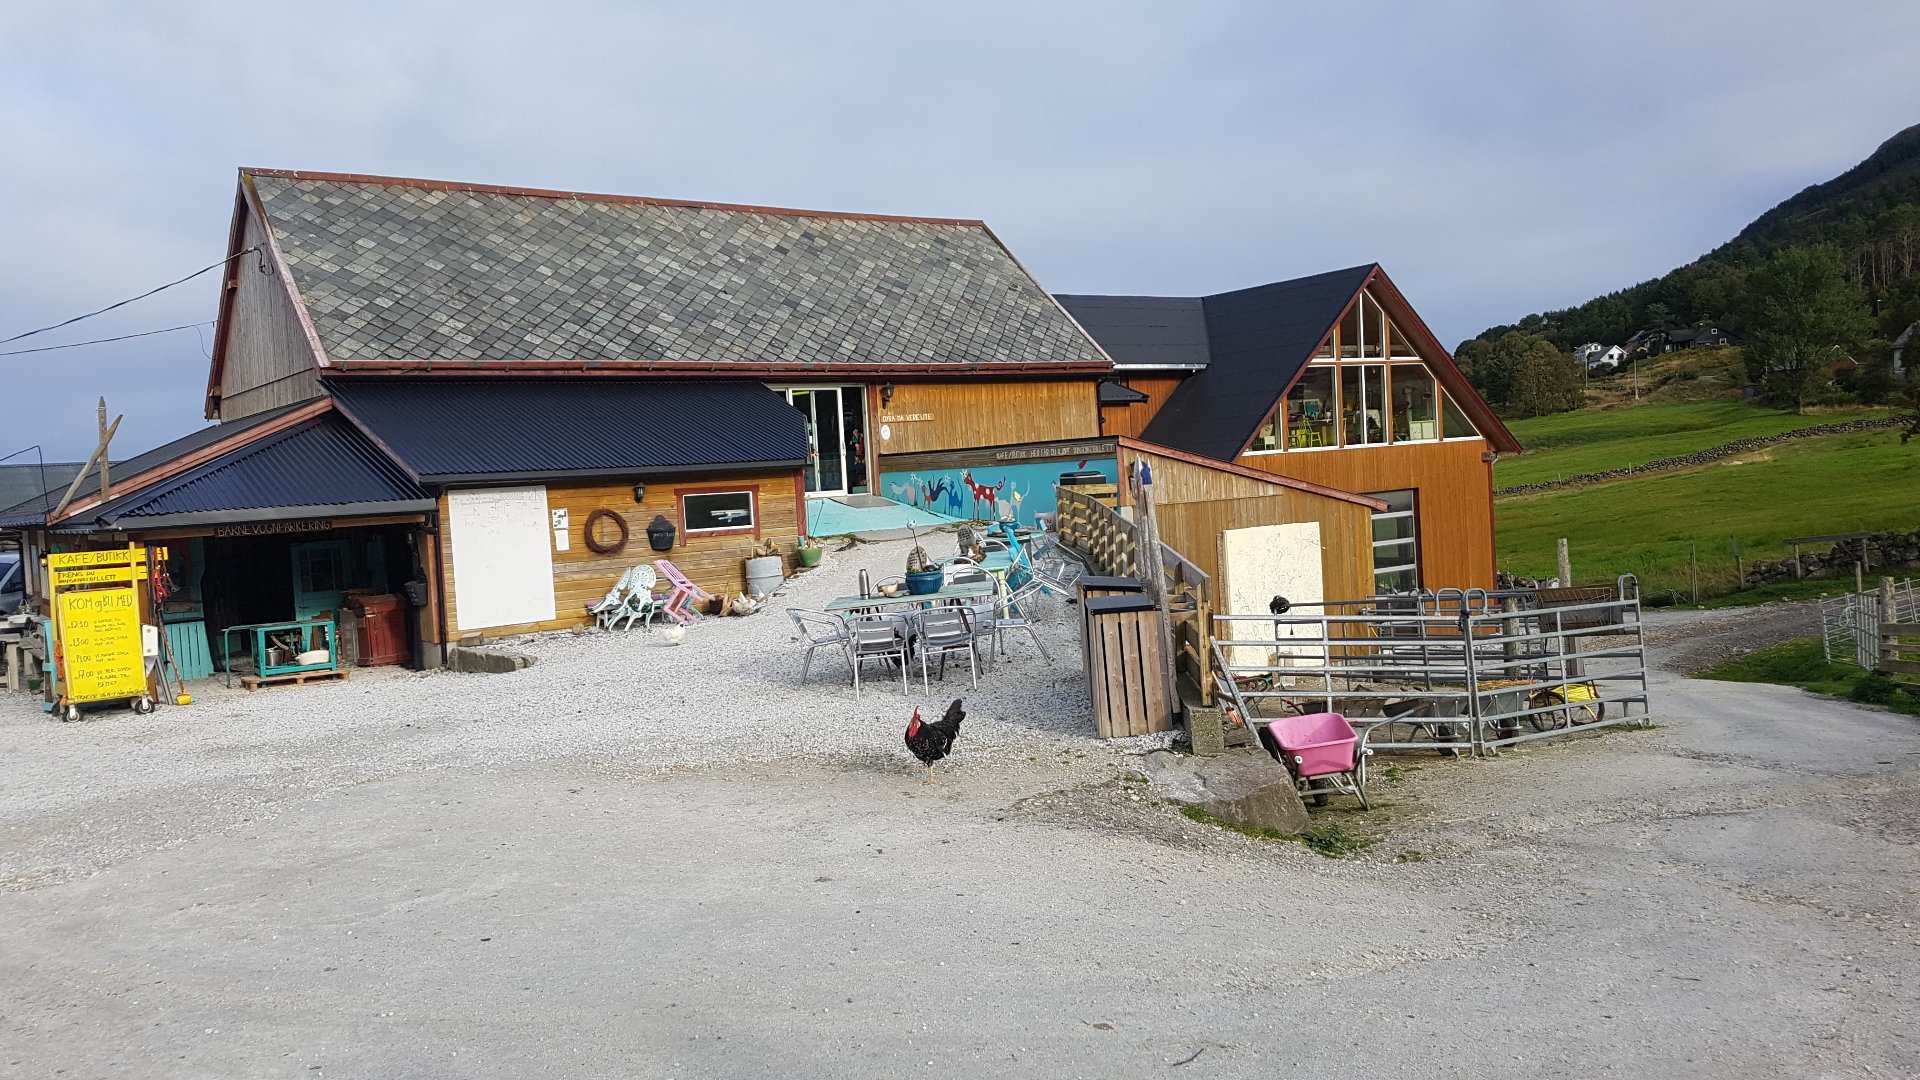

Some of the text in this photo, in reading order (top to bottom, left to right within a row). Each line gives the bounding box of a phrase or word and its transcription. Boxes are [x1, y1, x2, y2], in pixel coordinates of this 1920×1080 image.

[58, 551, 129, 565] KAFE/BUTIKK
[69, 597, 93, 611] KOM
[116, 594, 133, 607] MED
